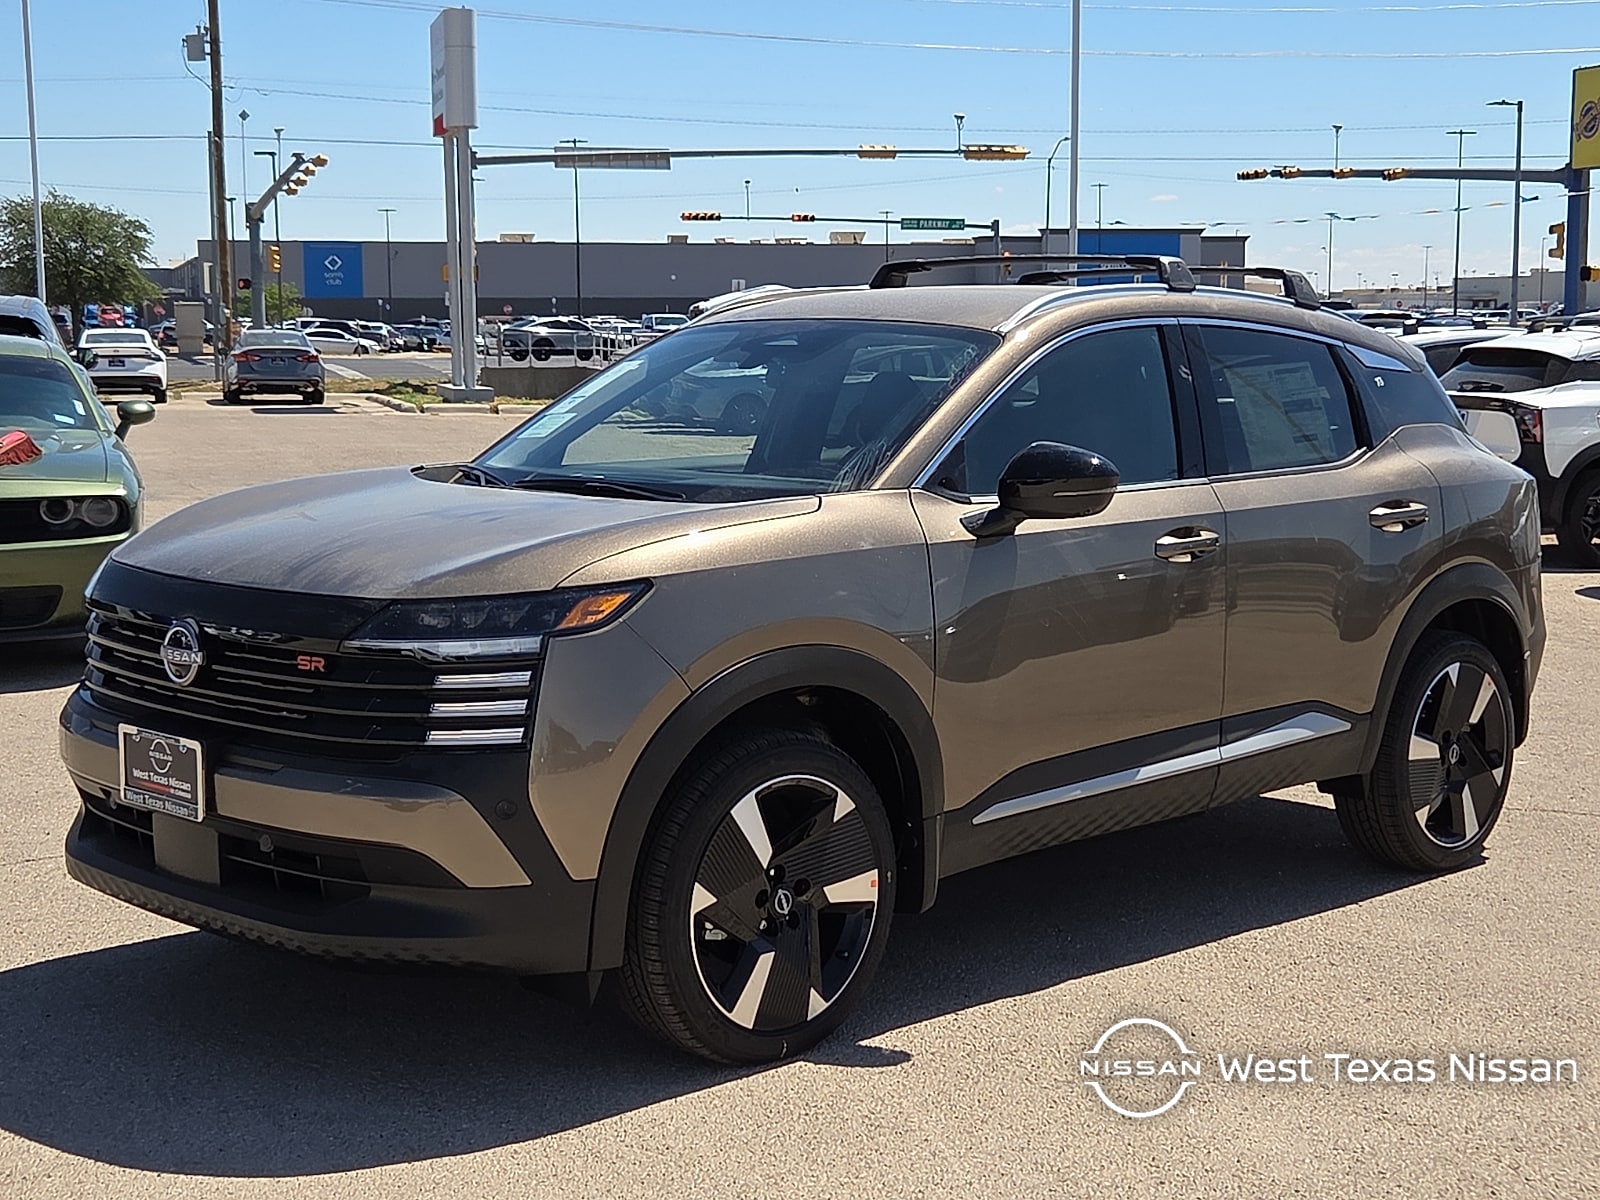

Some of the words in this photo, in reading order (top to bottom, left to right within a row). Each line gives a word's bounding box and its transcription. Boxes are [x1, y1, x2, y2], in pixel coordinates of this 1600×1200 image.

[919, 220, 950, 229] PARKWAY
[297, 655, 325, 672] SR
[132, 767, 149, 780] West
[150, 772, 169, 786] Texas
[169, 777, 192, 792] Nissan
[126, 790, 144, 804] West
[144, 794, 164, 809] Texas
[165, 799, 189, 816] Nissan
